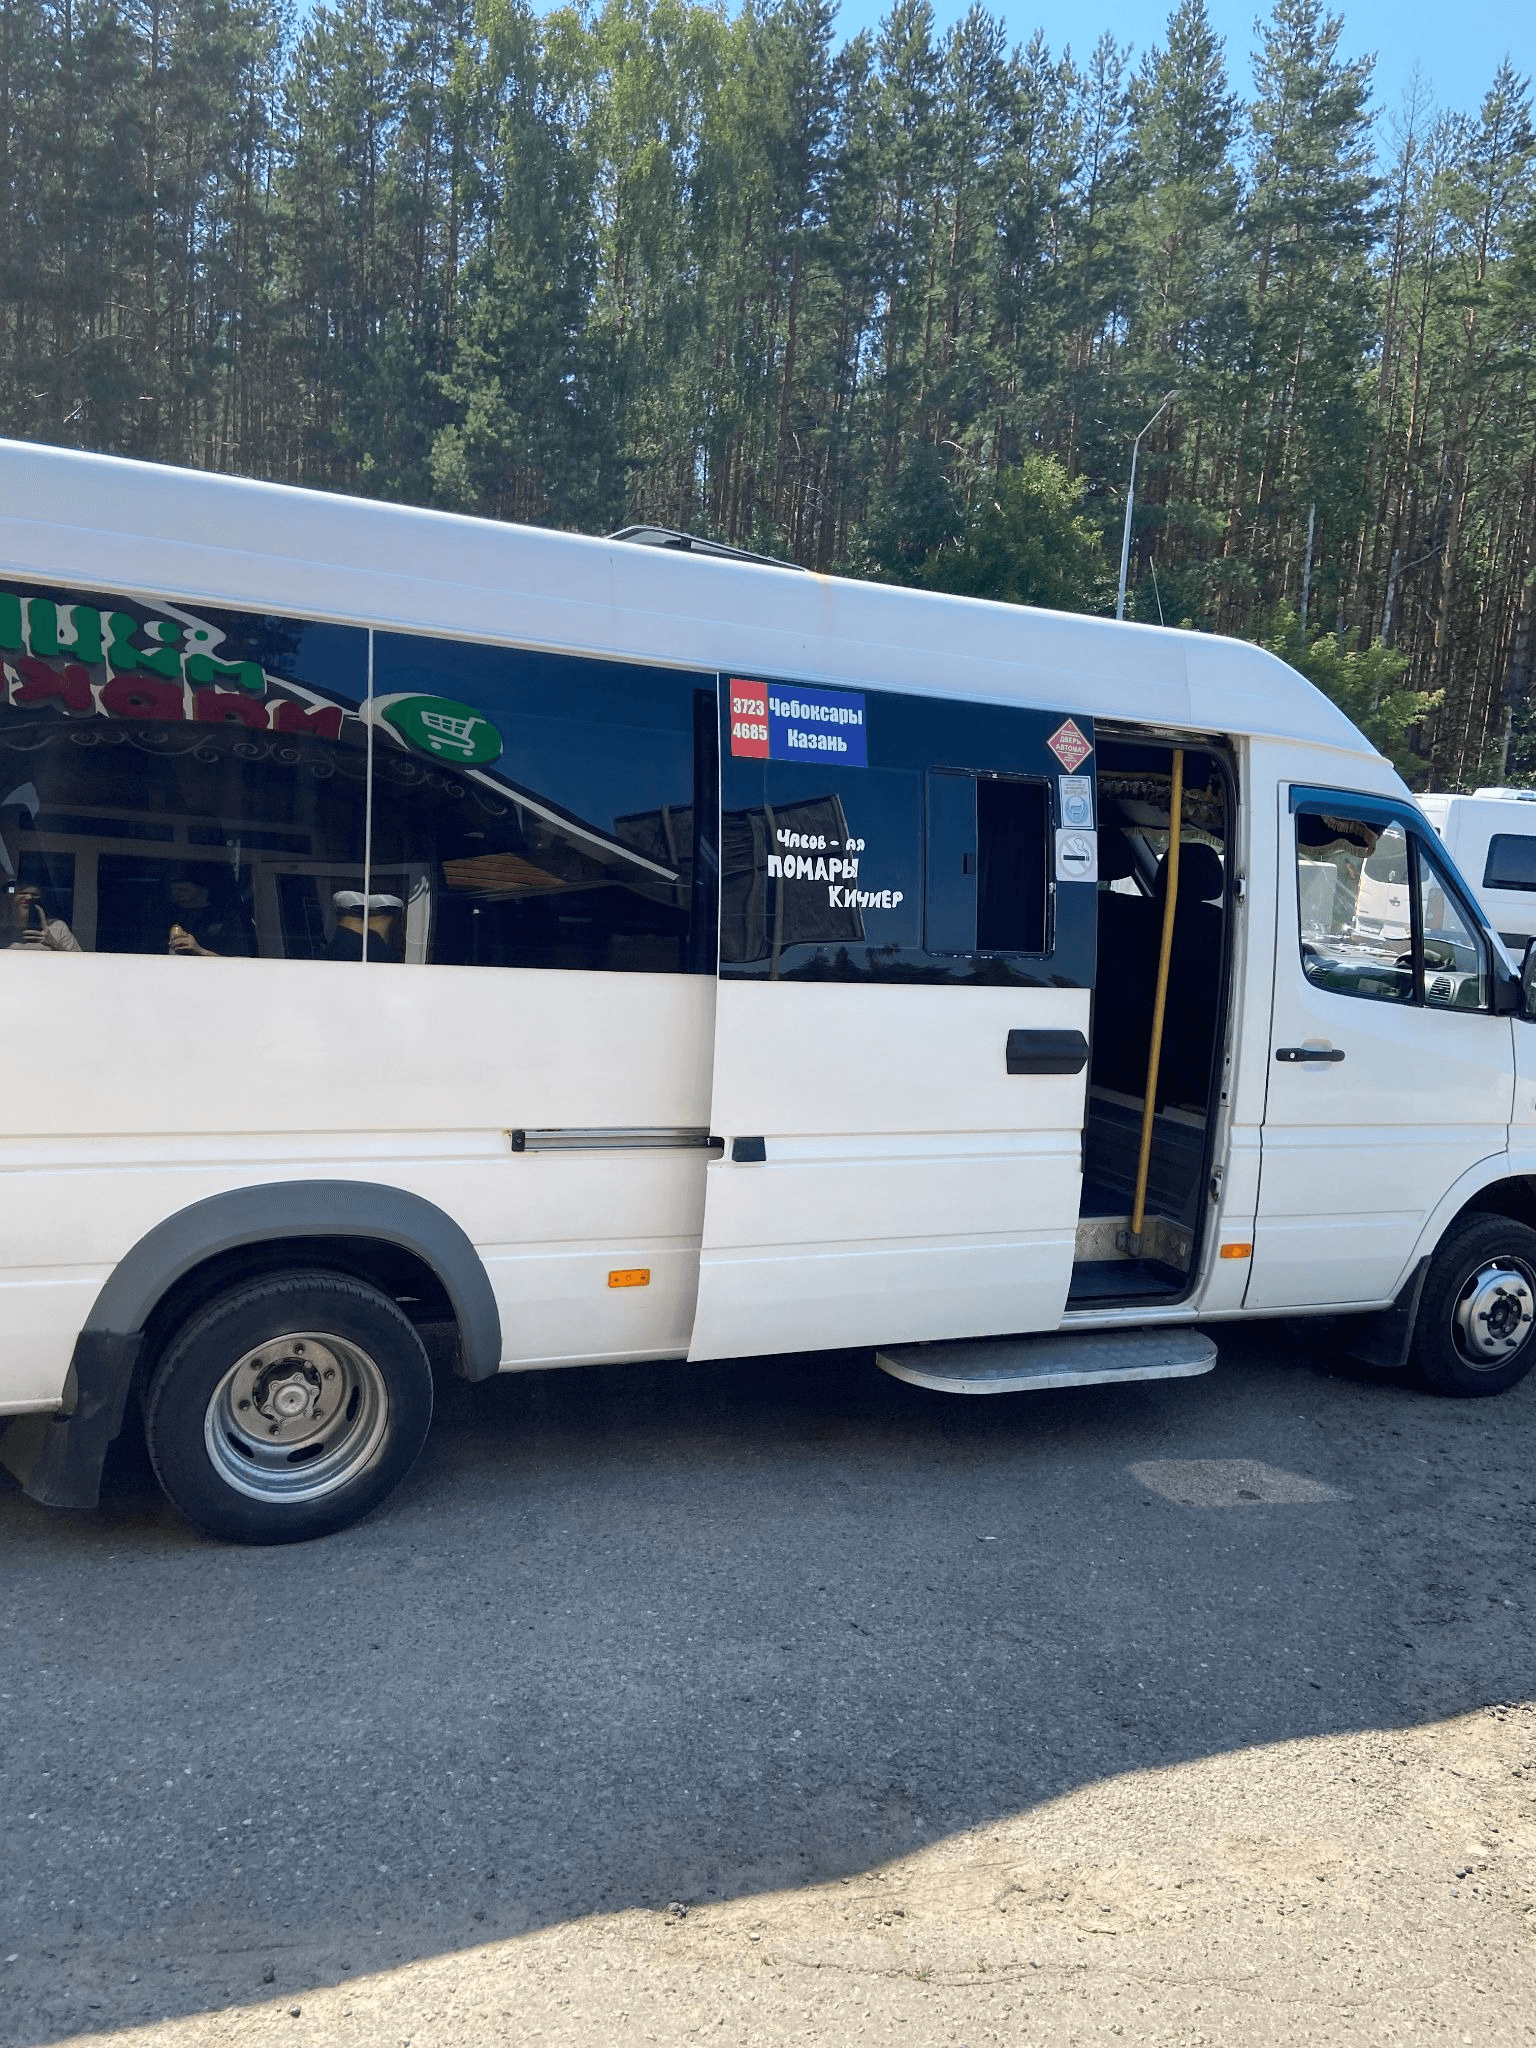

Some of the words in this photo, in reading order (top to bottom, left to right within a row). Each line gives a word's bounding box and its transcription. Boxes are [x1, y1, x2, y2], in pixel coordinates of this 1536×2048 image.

[733, 697, 765, 716] 3723
[768, 697, 863, 725] Чебоксары
[733, 722, 768, 741] 4685
[787, 728, 848, 752] Казань
[1060, 736, 1082, 745] ДВЕРЬ
[1055, 744, 1086, 754] АВТОМАТ
[767, 854, 860, 883] ПОМАРЫ
